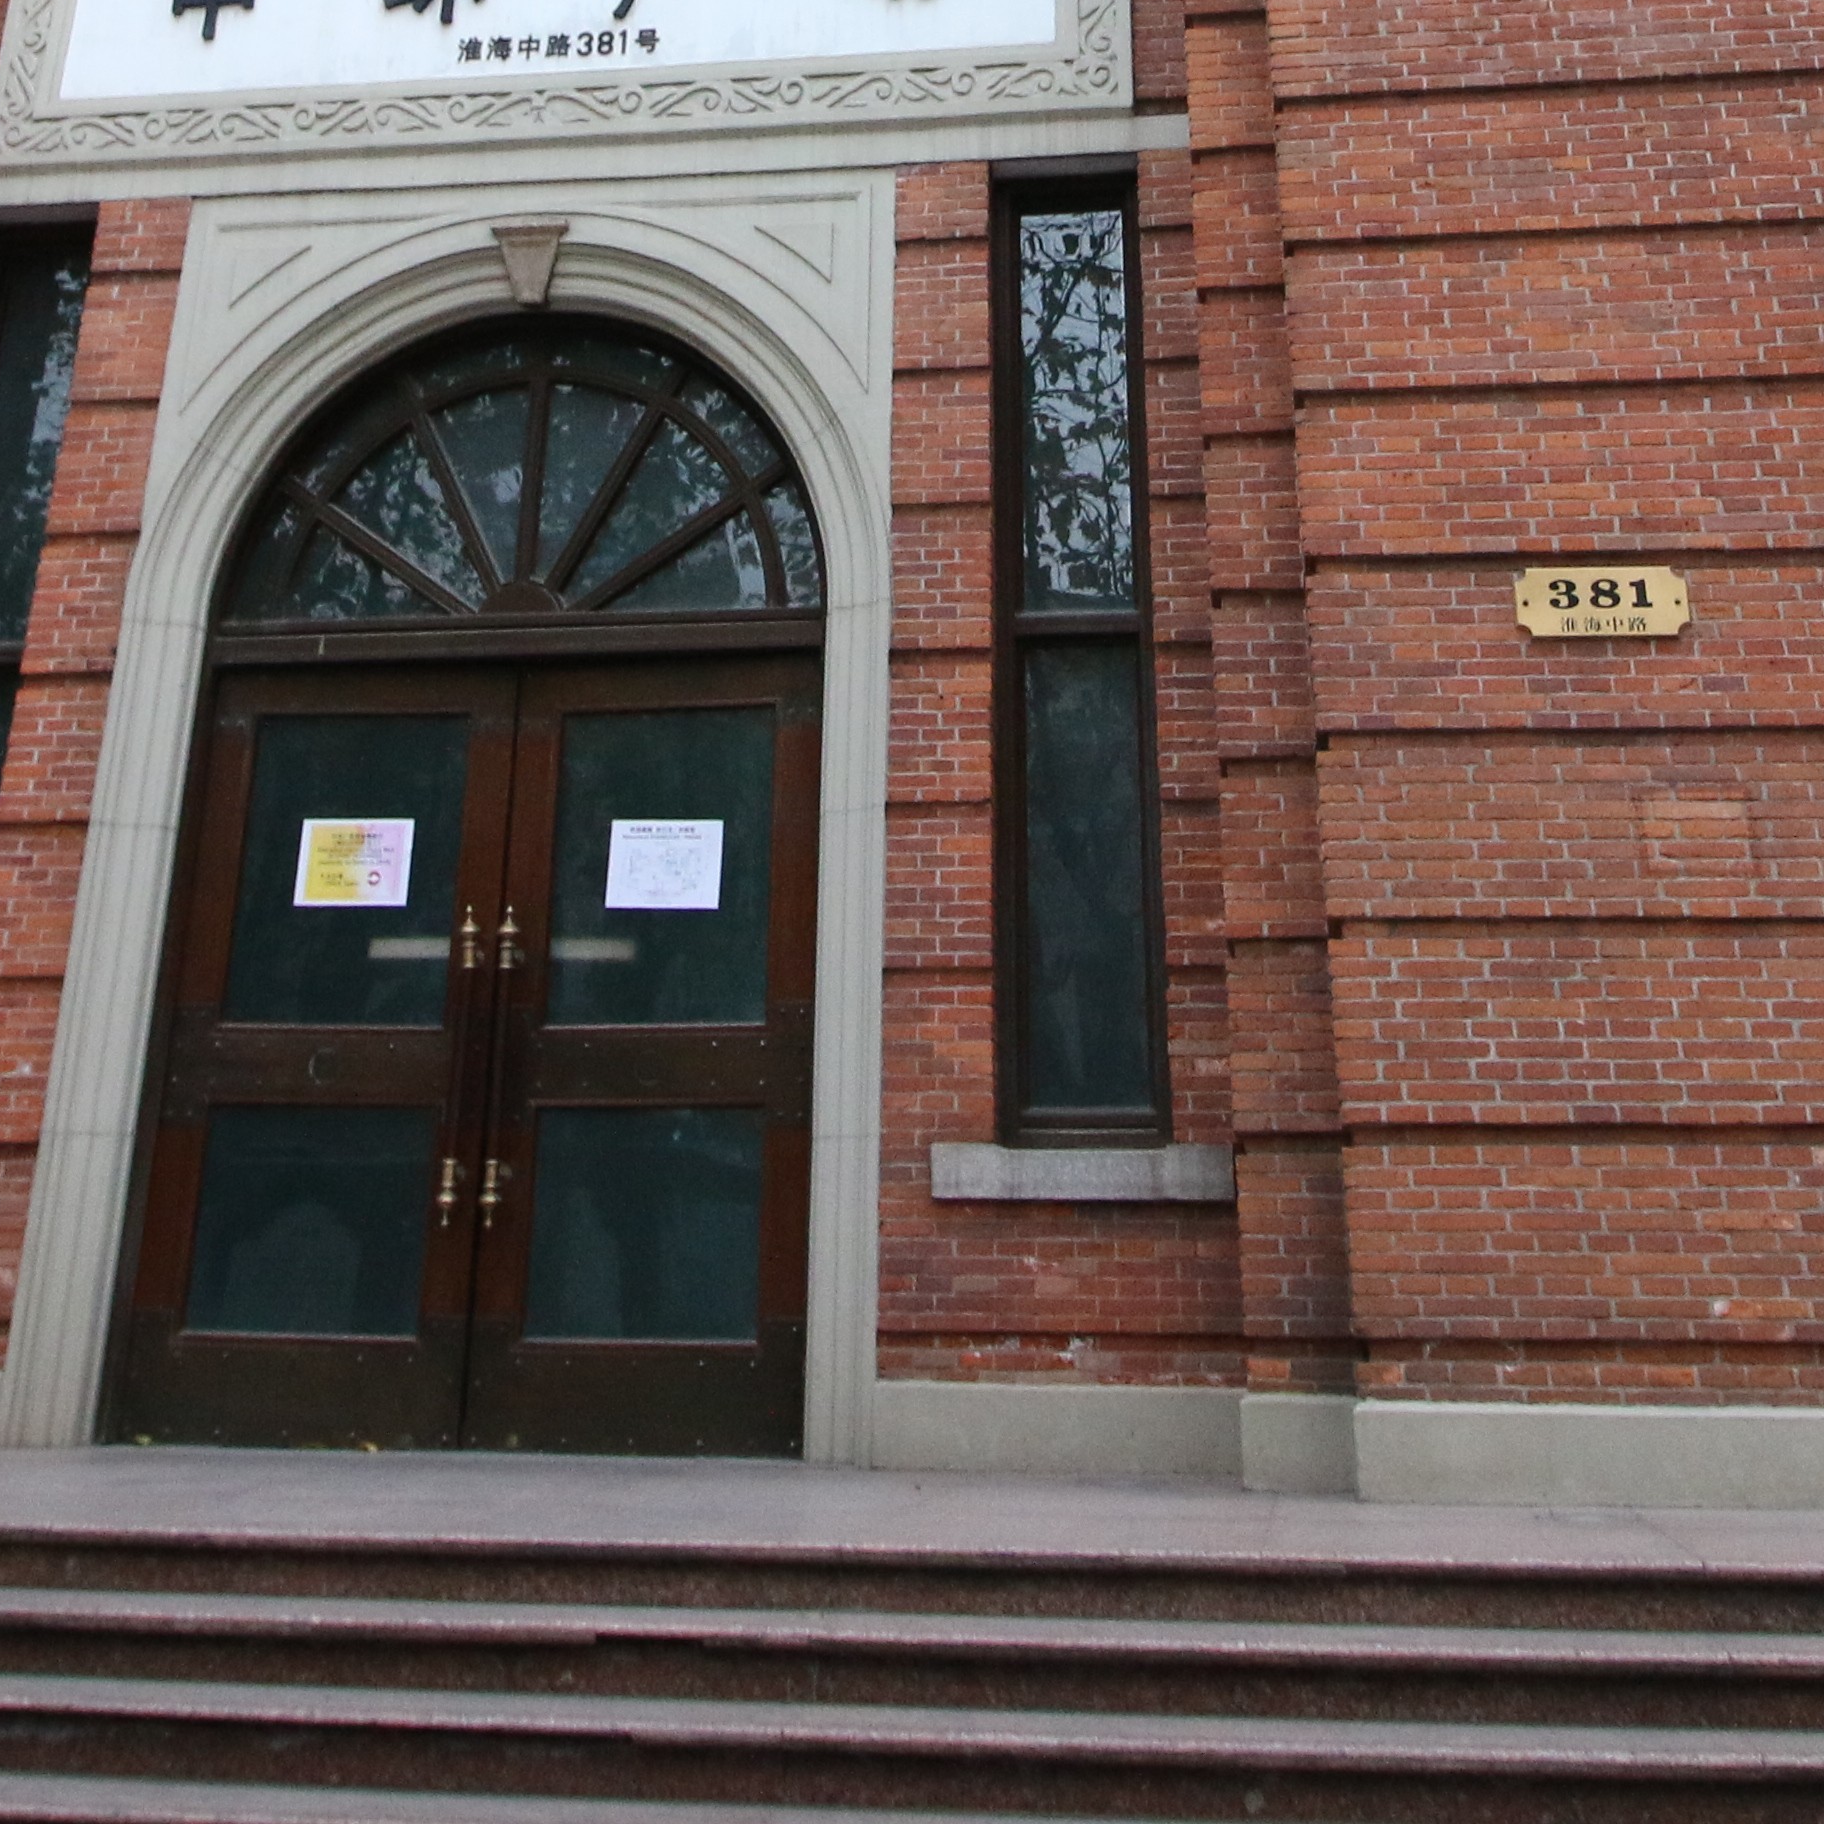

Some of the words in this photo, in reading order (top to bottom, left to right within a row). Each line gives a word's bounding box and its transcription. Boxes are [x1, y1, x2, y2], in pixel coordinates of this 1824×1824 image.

[457, 29, 660, 62] 淮海中路381号
[1548, 578, 1653, 610] 381
